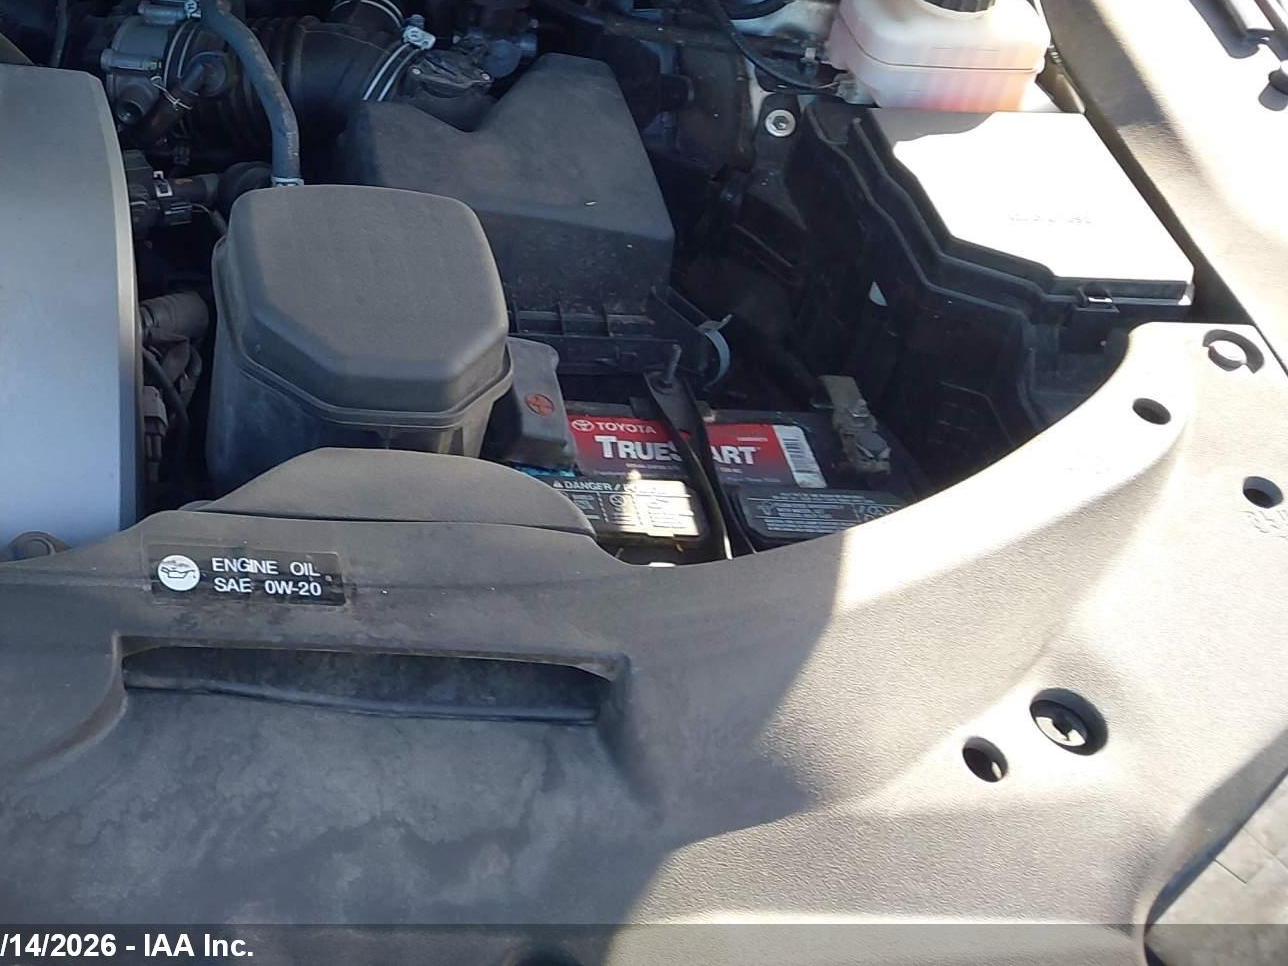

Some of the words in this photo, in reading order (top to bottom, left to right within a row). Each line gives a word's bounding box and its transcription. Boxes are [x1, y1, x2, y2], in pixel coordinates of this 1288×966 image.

[594, 420, 657, 434] TOYOTA
[562, 480, 613, 491] DANGER
[211, 557, 279, 575] ENGINE
[289, 561, 321, 577] OIL
[213, 577, 252, 594] SAE
[264, 580, 322, 597] 0W-20
